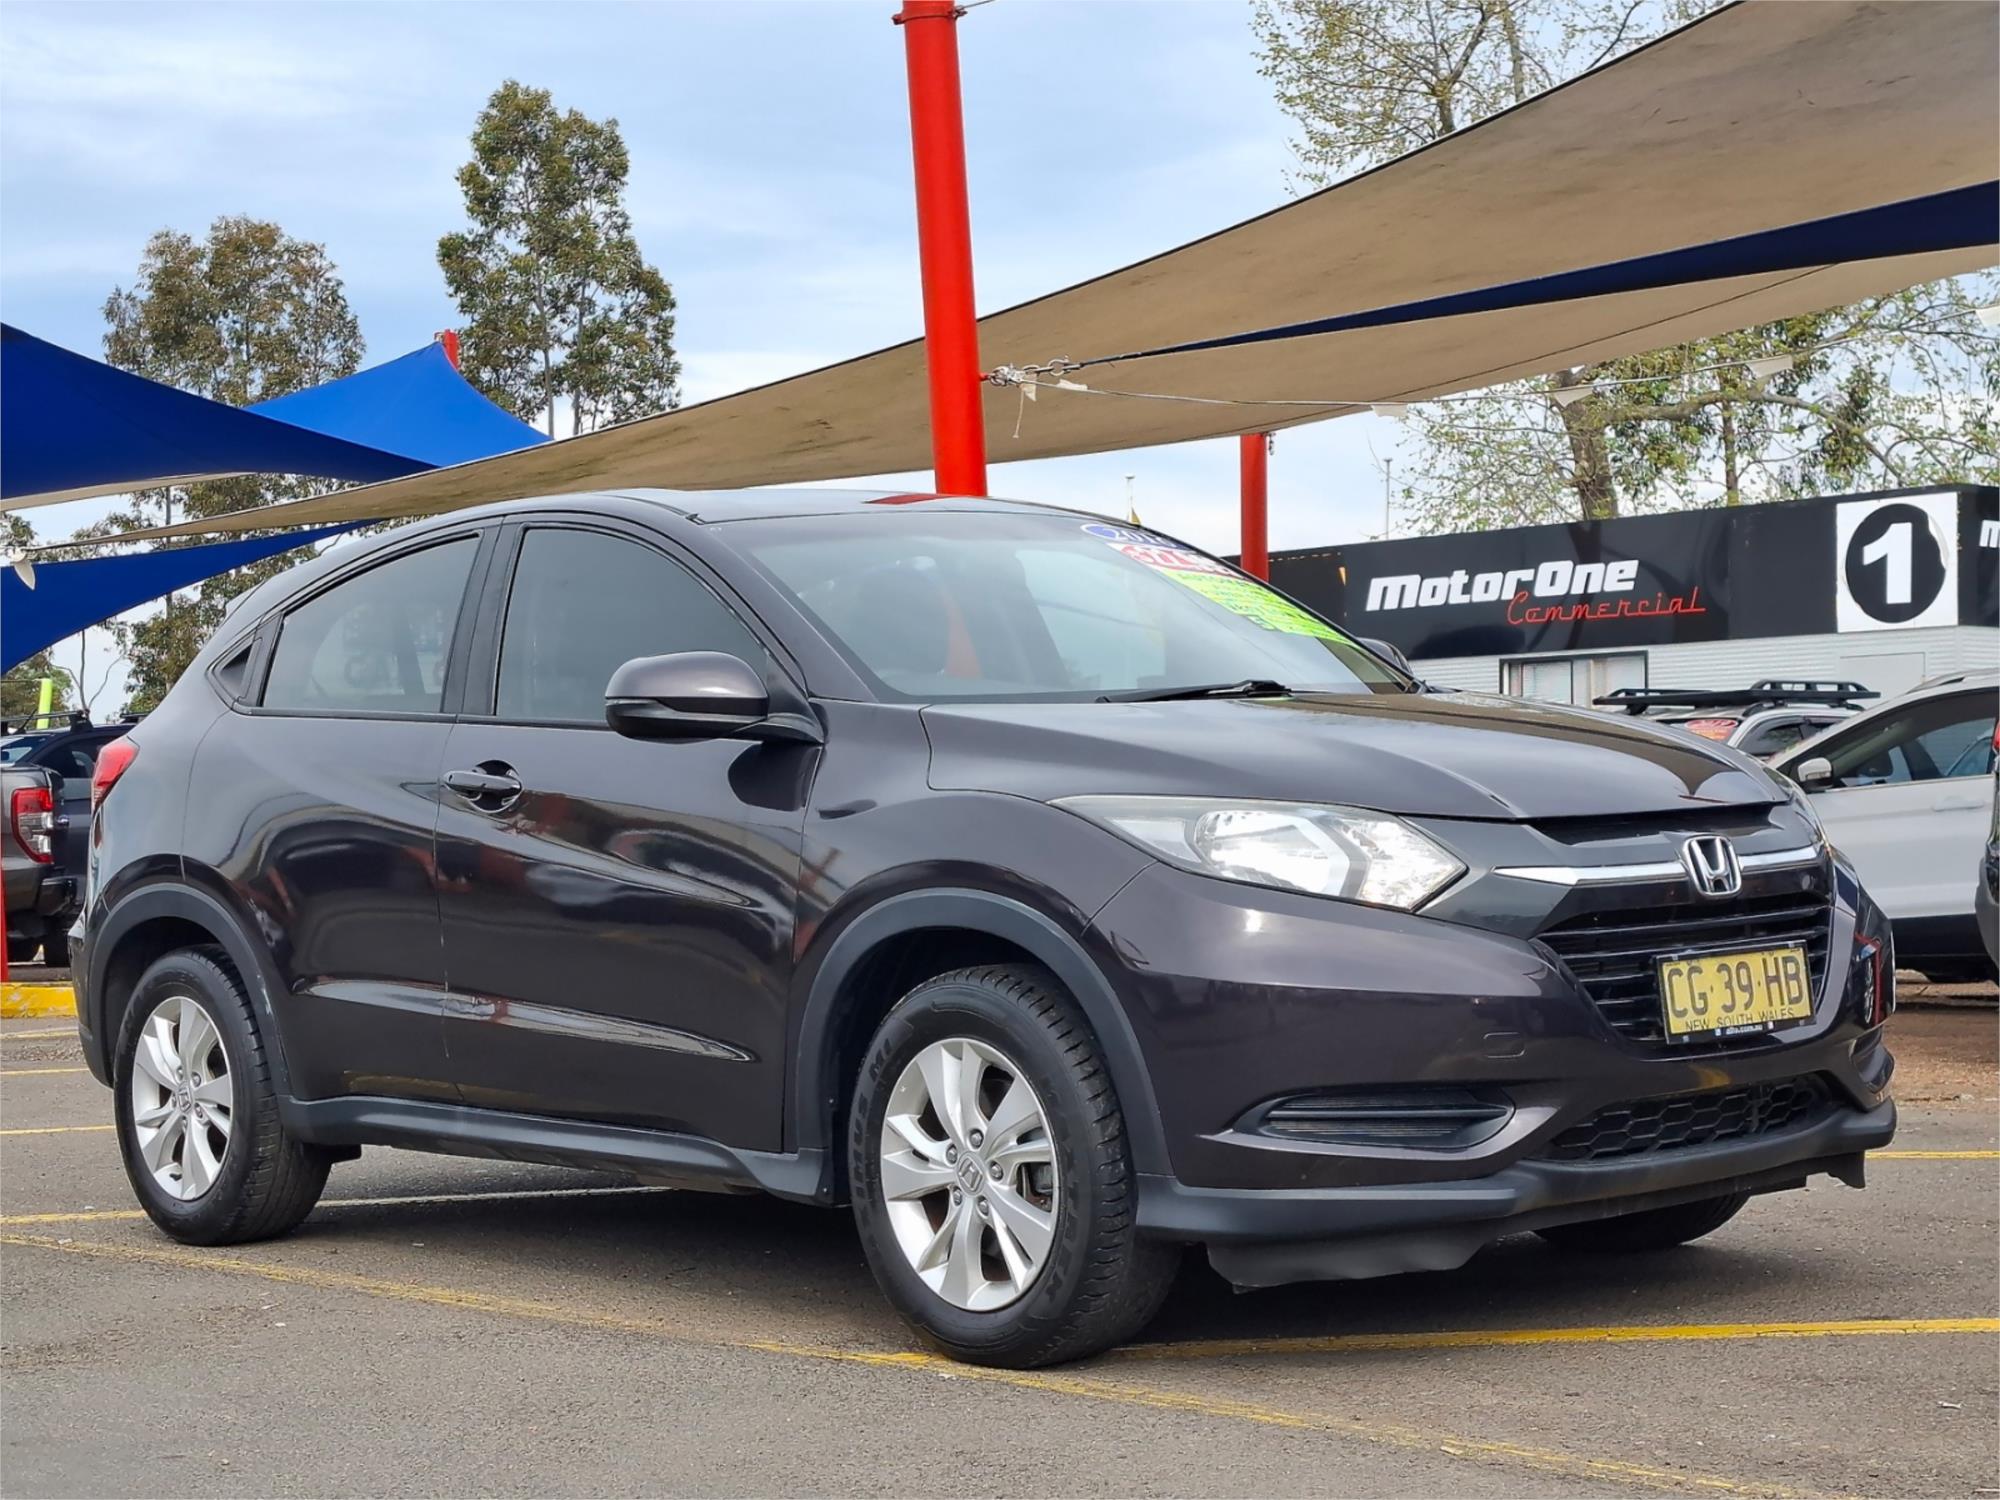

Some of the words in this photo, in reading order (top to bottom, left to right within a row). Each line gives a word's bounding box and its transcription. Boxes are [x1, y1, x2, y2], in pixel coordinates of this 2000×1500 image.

[1862, 521, 1912, 604] 1
[1365, 559, 1639, 611] MotorOne
[1507, 587, 1706, 624] Commercial
[1685, 1018, 1710, 1031] NEW
[1716, 1013, 1754, 1027] SOUTH
[1758, 1007, 1795, 1022] WALES
